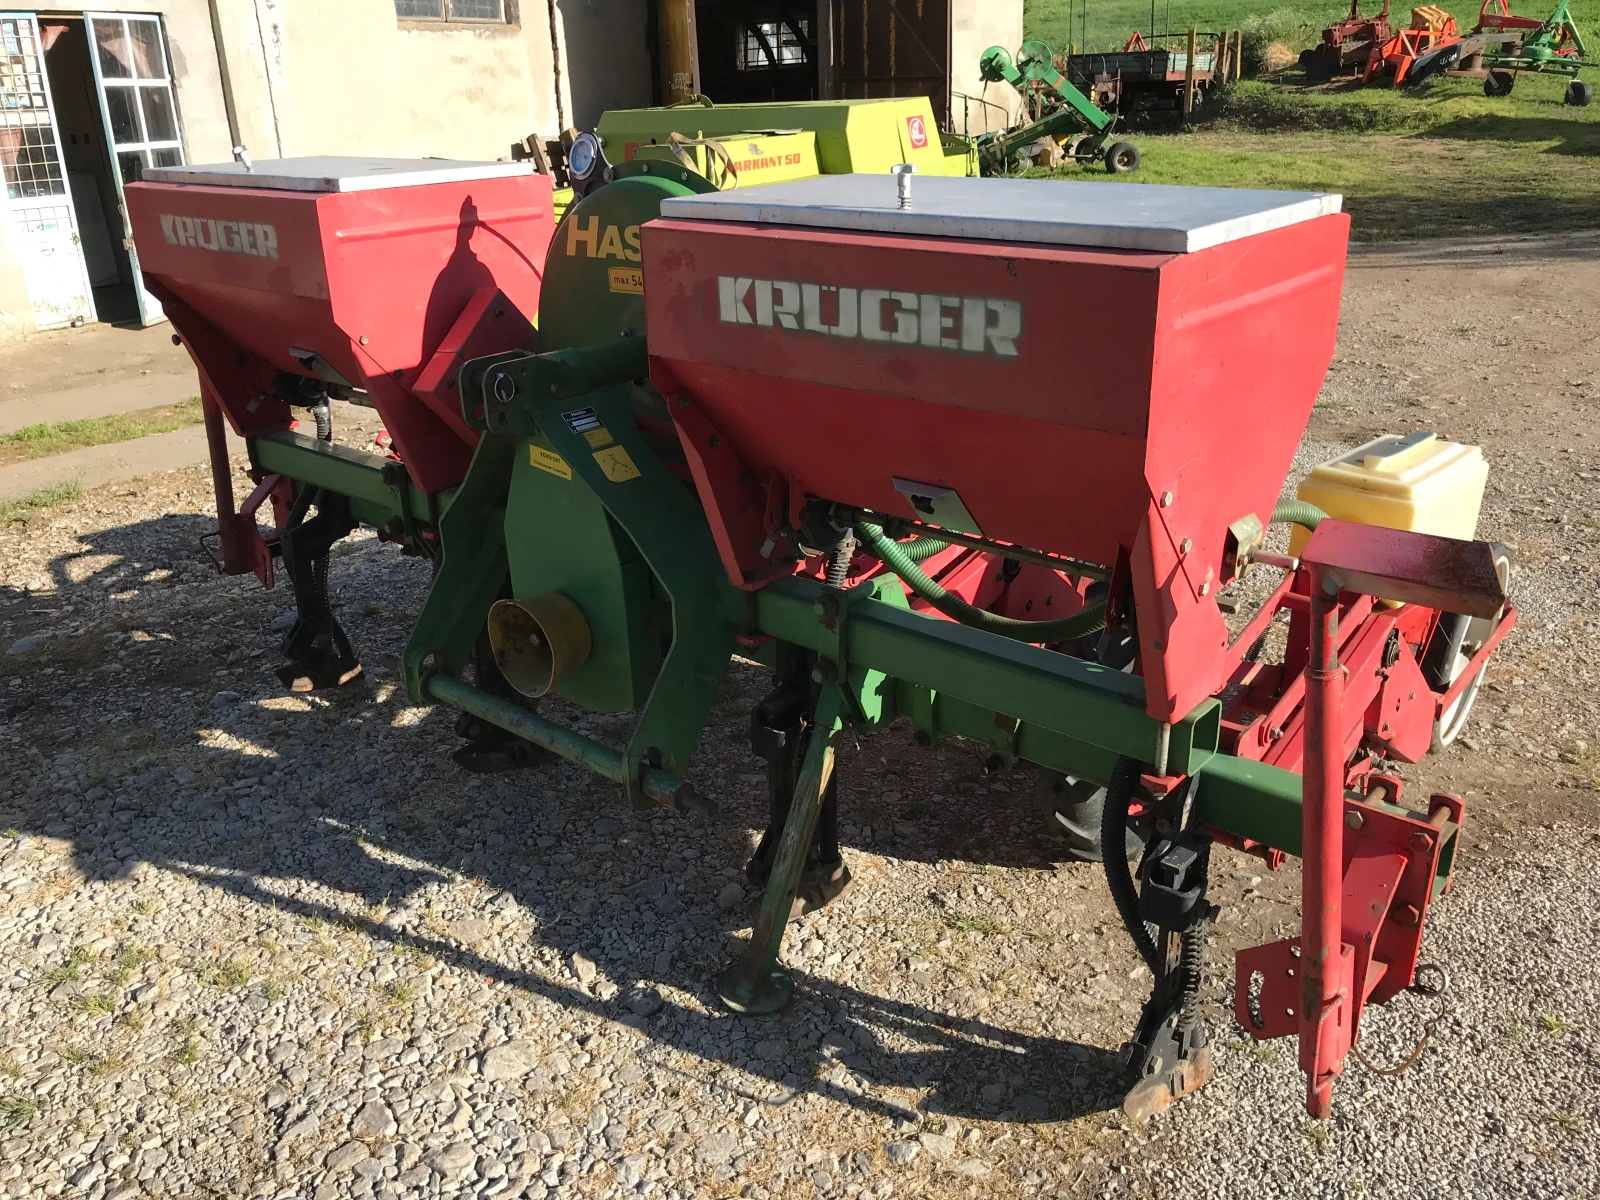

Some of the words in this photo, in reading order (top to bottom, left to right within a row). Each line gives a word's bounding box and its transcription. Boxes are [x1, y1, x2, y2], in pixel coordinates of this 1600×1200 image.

[785, 153, 801, 165] 50
[159, 214, 279, 259] KRÜGER
[614, 276, 629, 286] max
[718, 276, 1021, 356] KRÜGER
